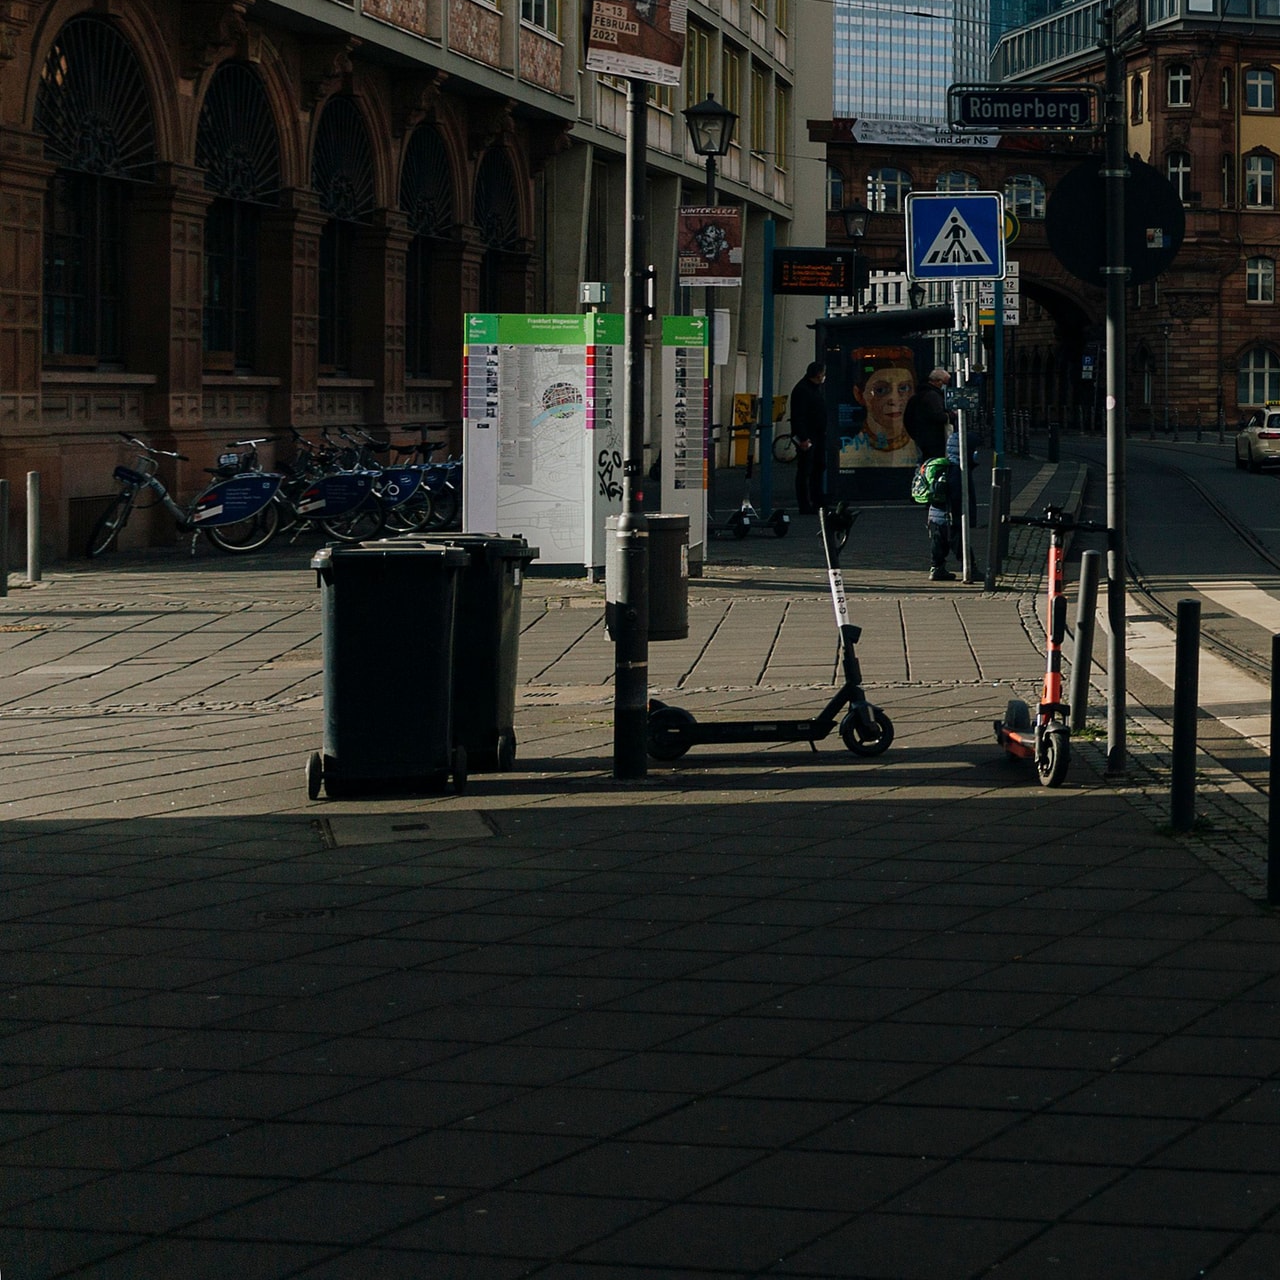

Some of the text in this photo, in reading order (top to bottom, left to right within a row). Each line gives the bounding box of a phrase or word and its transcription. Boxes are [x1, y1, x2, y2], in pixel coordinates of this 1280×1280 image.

[594, 16, 637, 32] FEBRUAR
[592, 30, 615, 42] 2022
[969, 97, 1080, 123] Römerberg
[934, 135, 988, 144] und der NS
